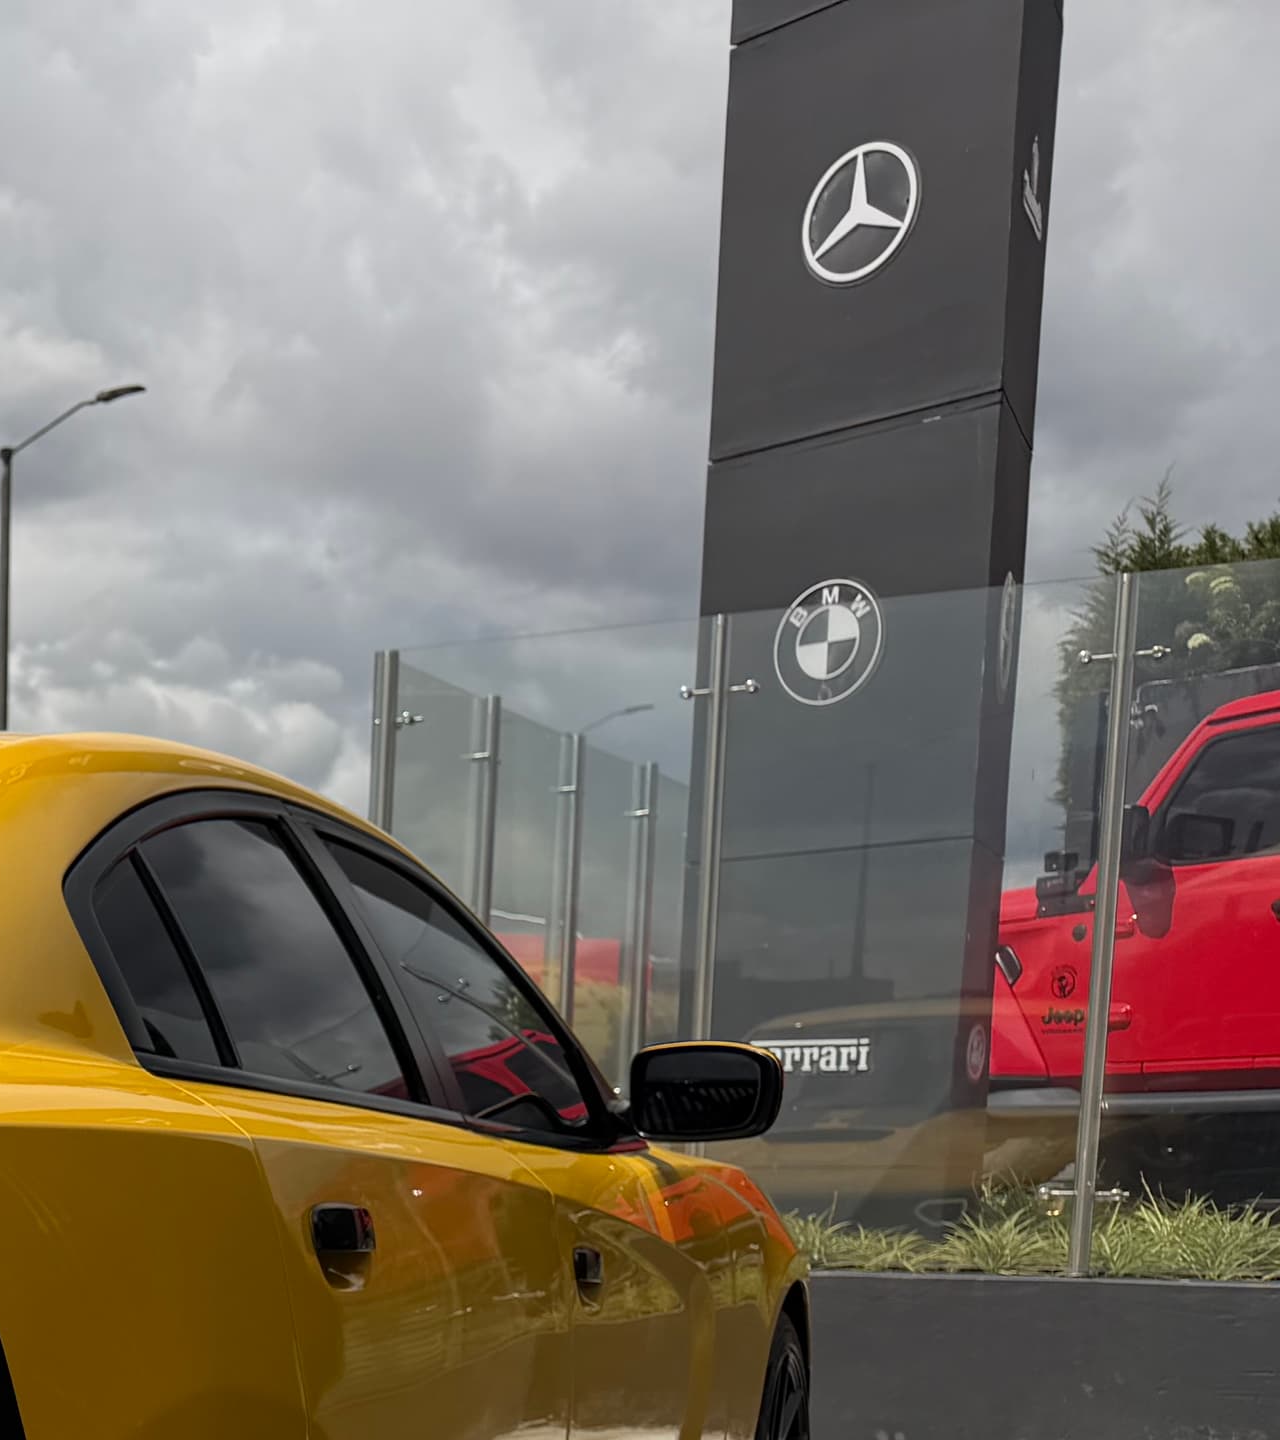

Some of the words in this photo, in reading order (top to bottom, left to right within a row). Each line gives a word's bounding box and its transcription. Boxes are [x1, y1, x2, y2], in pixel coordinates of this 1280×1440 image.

[789, 586, 871, 629] BMW
[1041, 1007, 1085, 1026] Jeep
[751, 1037, 870, 1072] rrari
